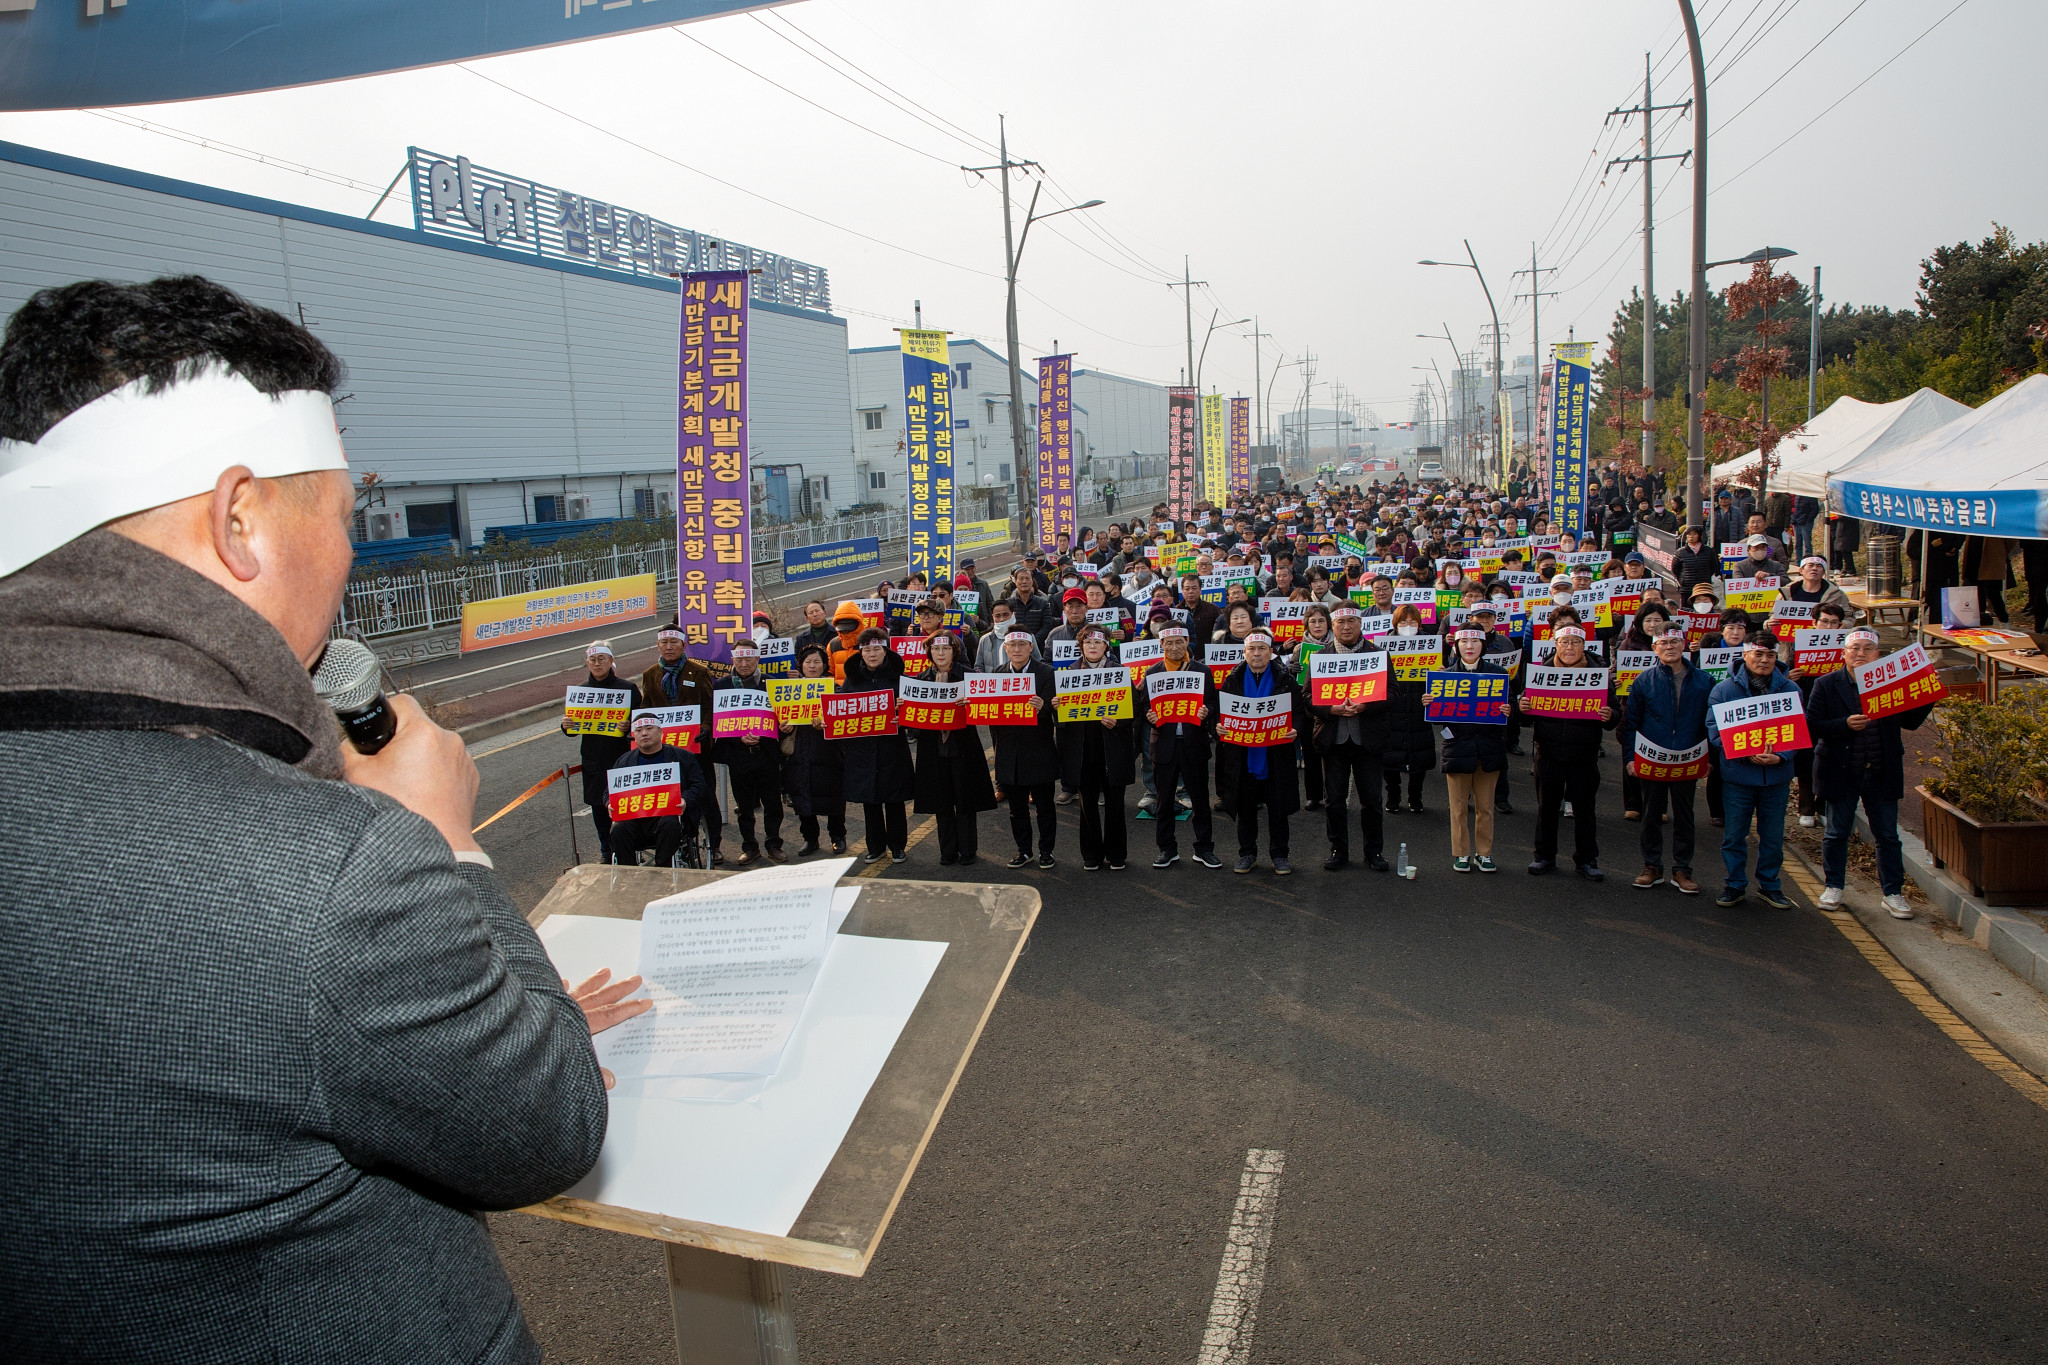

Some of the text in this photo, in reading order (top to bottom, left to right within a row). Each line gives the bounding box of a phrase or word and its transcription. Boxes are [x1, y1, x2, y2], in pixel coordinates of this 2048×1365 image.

[709, 280, 743, 483] 새만금개발청
[1056, 359, 1070, 413] 기울어진
[931, 372, 953, 468] 관리기관의
[1554, 364, 1571, 492] 새만금사업의 핵심 인프라
[1569, 383, 1585, 460] 새만금기본계획
[1182, 432, 1194, 453] 국가
[908, 384, 930, 521] 새만금개발청은
[682, 280, 709, 645] 새만금기본계획 새만금신항 유지 및
[1039, 450, 1054, 490] 아니라
[1057, 464, 1072, 491] 바로
[1170, 468, 1181, 499] 새만금
[934, 477, 952, 535] 본분을
[1860, 490, 1996, 528] 운영부스(따뜻한음료)
[1040, 494, 1056, 547] 개발청의
[1566, 508, 1579, 531] 유지
[710, 498, 744, 564] 중립
[1570, 553, 1608, 563] 새만금신항
[1614, 581, 1657, 595] 살려내라
[1727, 578, 1777, 590] 도민의 새만금
[596, 588, 609, 599] 없다!
[1394, 591, 1432, 602] 만금신항
[1573, 591, 1605, 604] 금개발청
[474, 616, 533, 640] 새만금개발청은
[534, 611, 565, 629] 국가계획
[566, 603, 602, 624] 관리기관의
[603, 598, 624, 616] 본분을
[625, 596, 648, 612] 지켜라!
[712, 579, 747, 645] 촉구
[1086, 611, 1113, 622] 금신항
[1380, 638, 1436, 652] 새만금개발청
[1808, 634, 1831, 646] 군산
[1863, 632, 1875, 640] 유지
[760, 641, 790, 655] 금신항
[1798, 651, 1835, 663] 받아쓰기
[1317, 657, 1380, 673] 새만금개발청
[1418, 655, 1437, 665] 행정
[1863, 647, 1926, 688] 항의엔 빠르게
[1060, 671, 1124, 689] 새만금개발청
[1409, 668, 1429, 678] 중단
[1532, 672, 1603, 687] 새만금신항
[774, 684, 802, 702] 공정성
[903, 685, 959, 699] 새만금개발청
[969, 677, 1031, 694] 항의엔 빠르게
[1151, 677, 1200, 694] 새만금개발청
[1321, 680, 1376, 700] 엄정중립
[1430, 678, 1505, 698] 중립은 말뿐
[1867, 673, 1942, 714] 계획엔 무책임
[568, 692, 625, 705] 새만금개발청
[827, 692, 889, 717] 새만금개발청
[1061, 689, 1126, 706] 무책임한 행정
[1530, 695, 1601, 712] 새만금기본계획 유지
[566, 709, 625, 720] 무책임한 행정
[905, 706, 955, 724] 엄정중립
[969, 702, 1034, 719] 계획엔 무책임
[1068, 704, 1119, 719] 즉각 중단
[1155, 699, 1197, 720] 엄정중립
[1231, 700, 1277, 714] 군산 주장
[1428, 701, 1503, 717] 결과는 편향
[1723, 698, 1793, 723] 새만금개발청
[597, 722, 618, 732] 중단
[716, 716, 775, 732] 새만금기본계획 유지
[832, 714, 887, 736] 엄정중립
[1223, 715, 1287, 731] 받아쓰기 100점
[1270, 727, 1288, 741] 0점
[1733, 723, 1795, 750] 엄정중립
[1639, 742, 1702, 762] 새만금개발청
[613, 768, 672, 789] 새만금개발청
[1639, 762, 1700, 777] 엄정중립
[618, 792, 670, 814] 엄정중립
